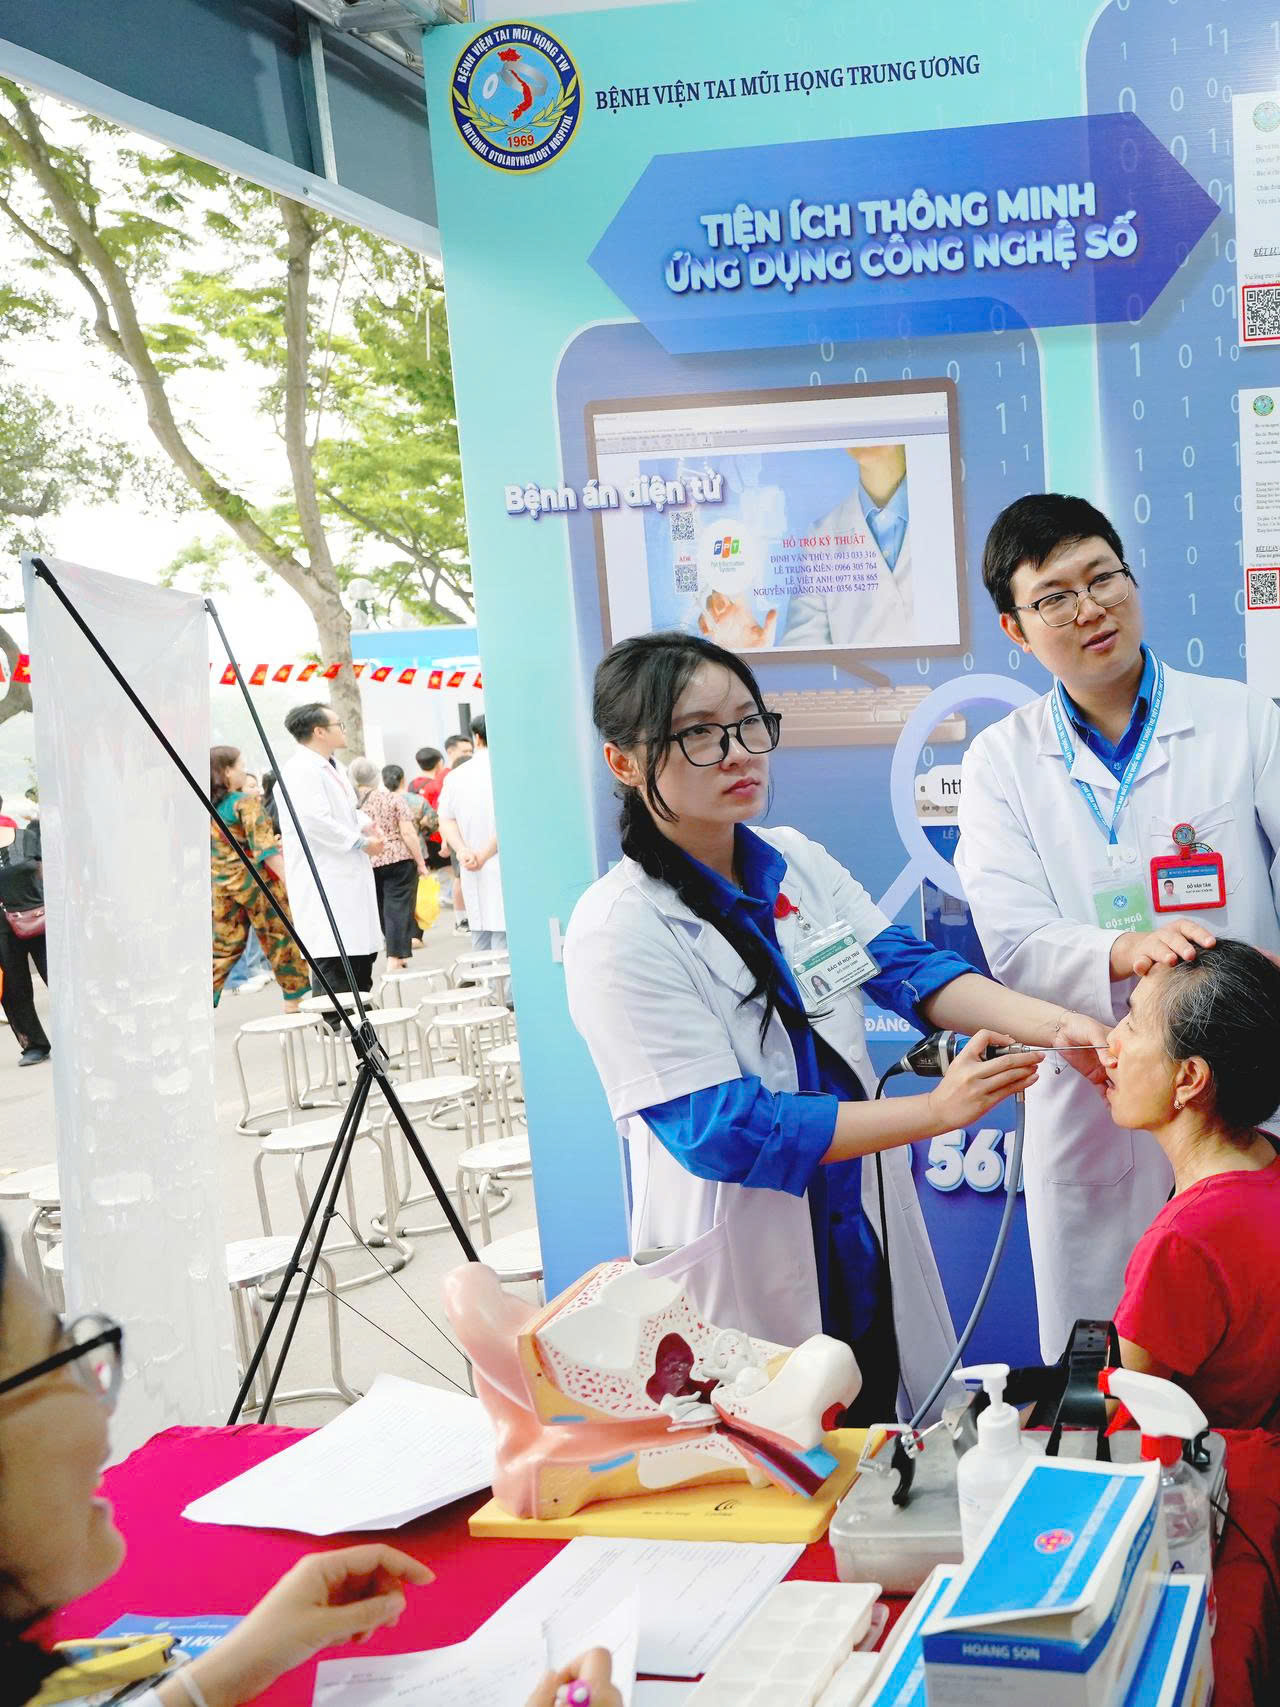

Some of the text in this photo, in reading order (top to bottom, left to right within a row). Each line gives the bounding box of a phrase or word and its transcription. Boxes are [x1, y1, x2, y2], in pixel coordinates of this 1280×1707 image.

[494, 29, 510, 42] TAI
[555, 54, 571, 72] TW
[595, 54, 981, 114] BỆNH VIỆN TAI MŨI HỌNG TRUNG ƯƠNG
[461, 115, 574, 167] NATIONAL OTOLARYNGOLOGY HOSPITAL
[507, 135, 535, 148] 1969
[700, 181, 1096, 253] TIỆN ÍCH THÔNG MINH
[664, 210, 1138, 293] ỨNG DỤNG CÔNG NGHỆ SỐ
[505, 482, 577, 520] Bệnh
[582, 479, 619, 509] án
[624, 475, 686, 513] điện
[714, 536, 741, 558] FPT
[834, 551, 850, 560] 0913
[834, 563, 850, 572] 0966
[866, 583, 879, 592] 777
[865, 1015, 910, 1032] ĐĂNG
